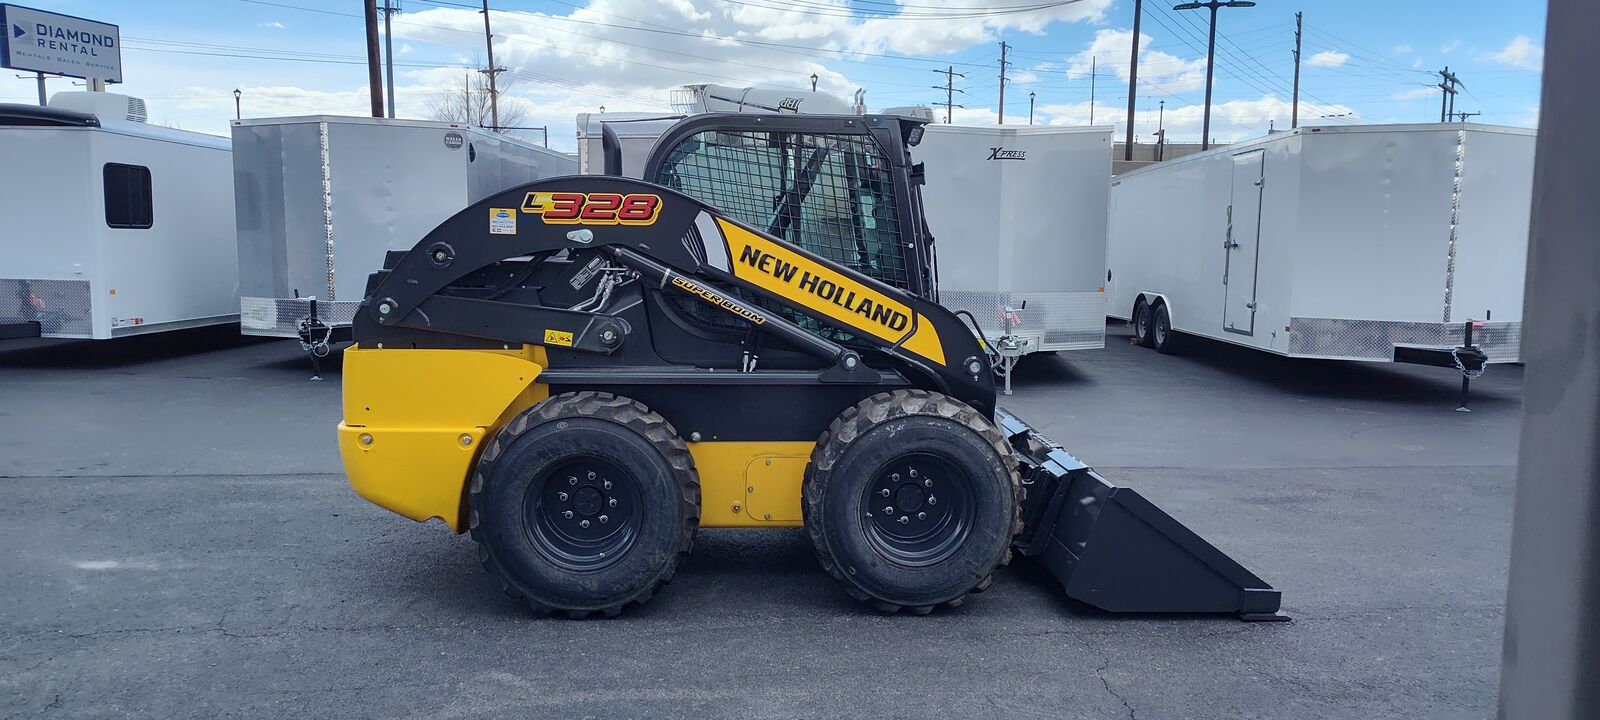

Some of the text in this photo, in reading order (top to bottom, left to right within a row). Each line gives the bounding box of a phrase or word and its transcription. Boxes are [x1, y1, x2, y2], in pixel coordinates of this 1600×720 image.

[36, 23, 114, 48] DIAMOND
[37, 38, 98, 57] RENTAL
[524, 193, 659, 222] L328
[672, 277, 765, 324] SUPER BOOM
[739, 244, 908, 332] NEW HOLLAND
